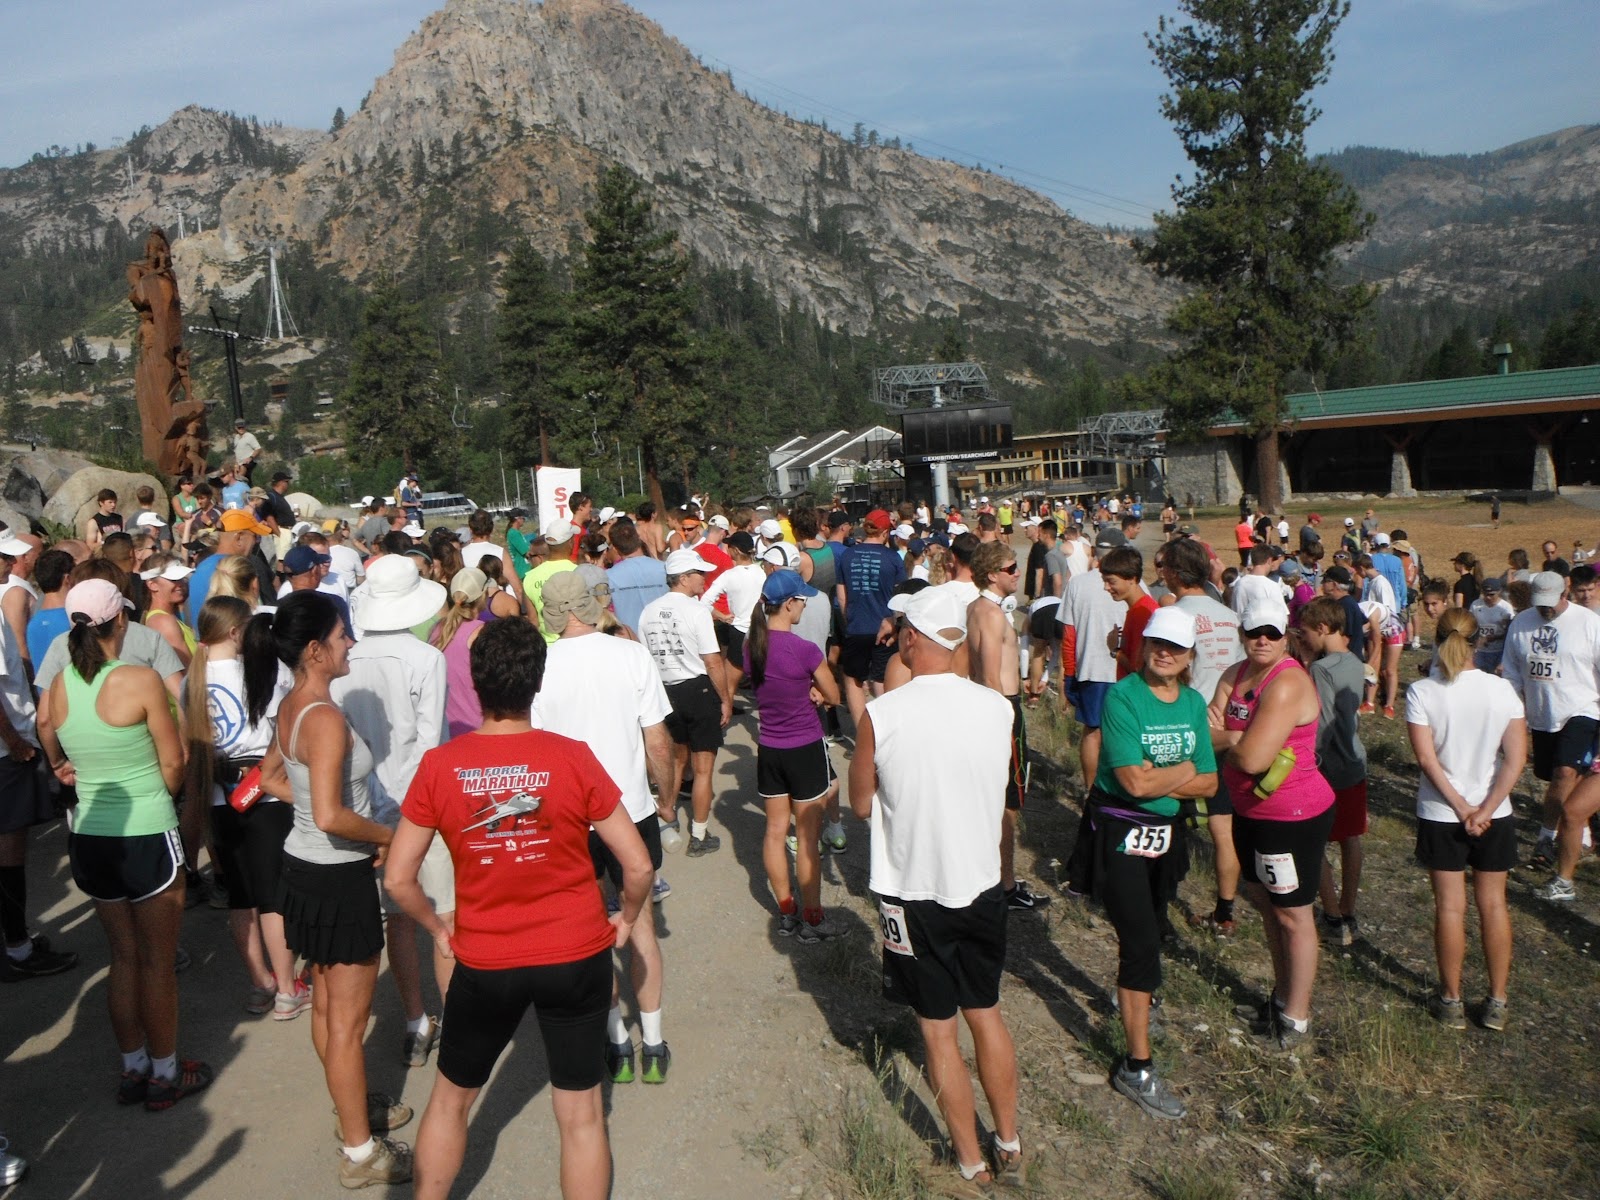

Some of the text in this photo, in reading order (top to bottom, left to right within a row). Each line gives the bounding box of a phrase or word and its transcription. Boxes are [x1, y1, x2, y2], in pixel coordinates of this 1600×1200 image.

[927, 451, 998, 461] EXHIBITION/SEARCHLIGHT
[1530, 661, 1552, 677] 205
[1141, 732, 1182, 745] EPPIE'S
[1150, 743, 1183, 755] GREAT
[1154, 753, 1181, 763] RACE
[458, 767, 482, 780] AIR
[484, 765, 528, 777] FORCE
[463, 772, 550, 793] MARATHON
[1132, 826, 1166, 852] 355
[1265, 864, 1277, 885] 5
